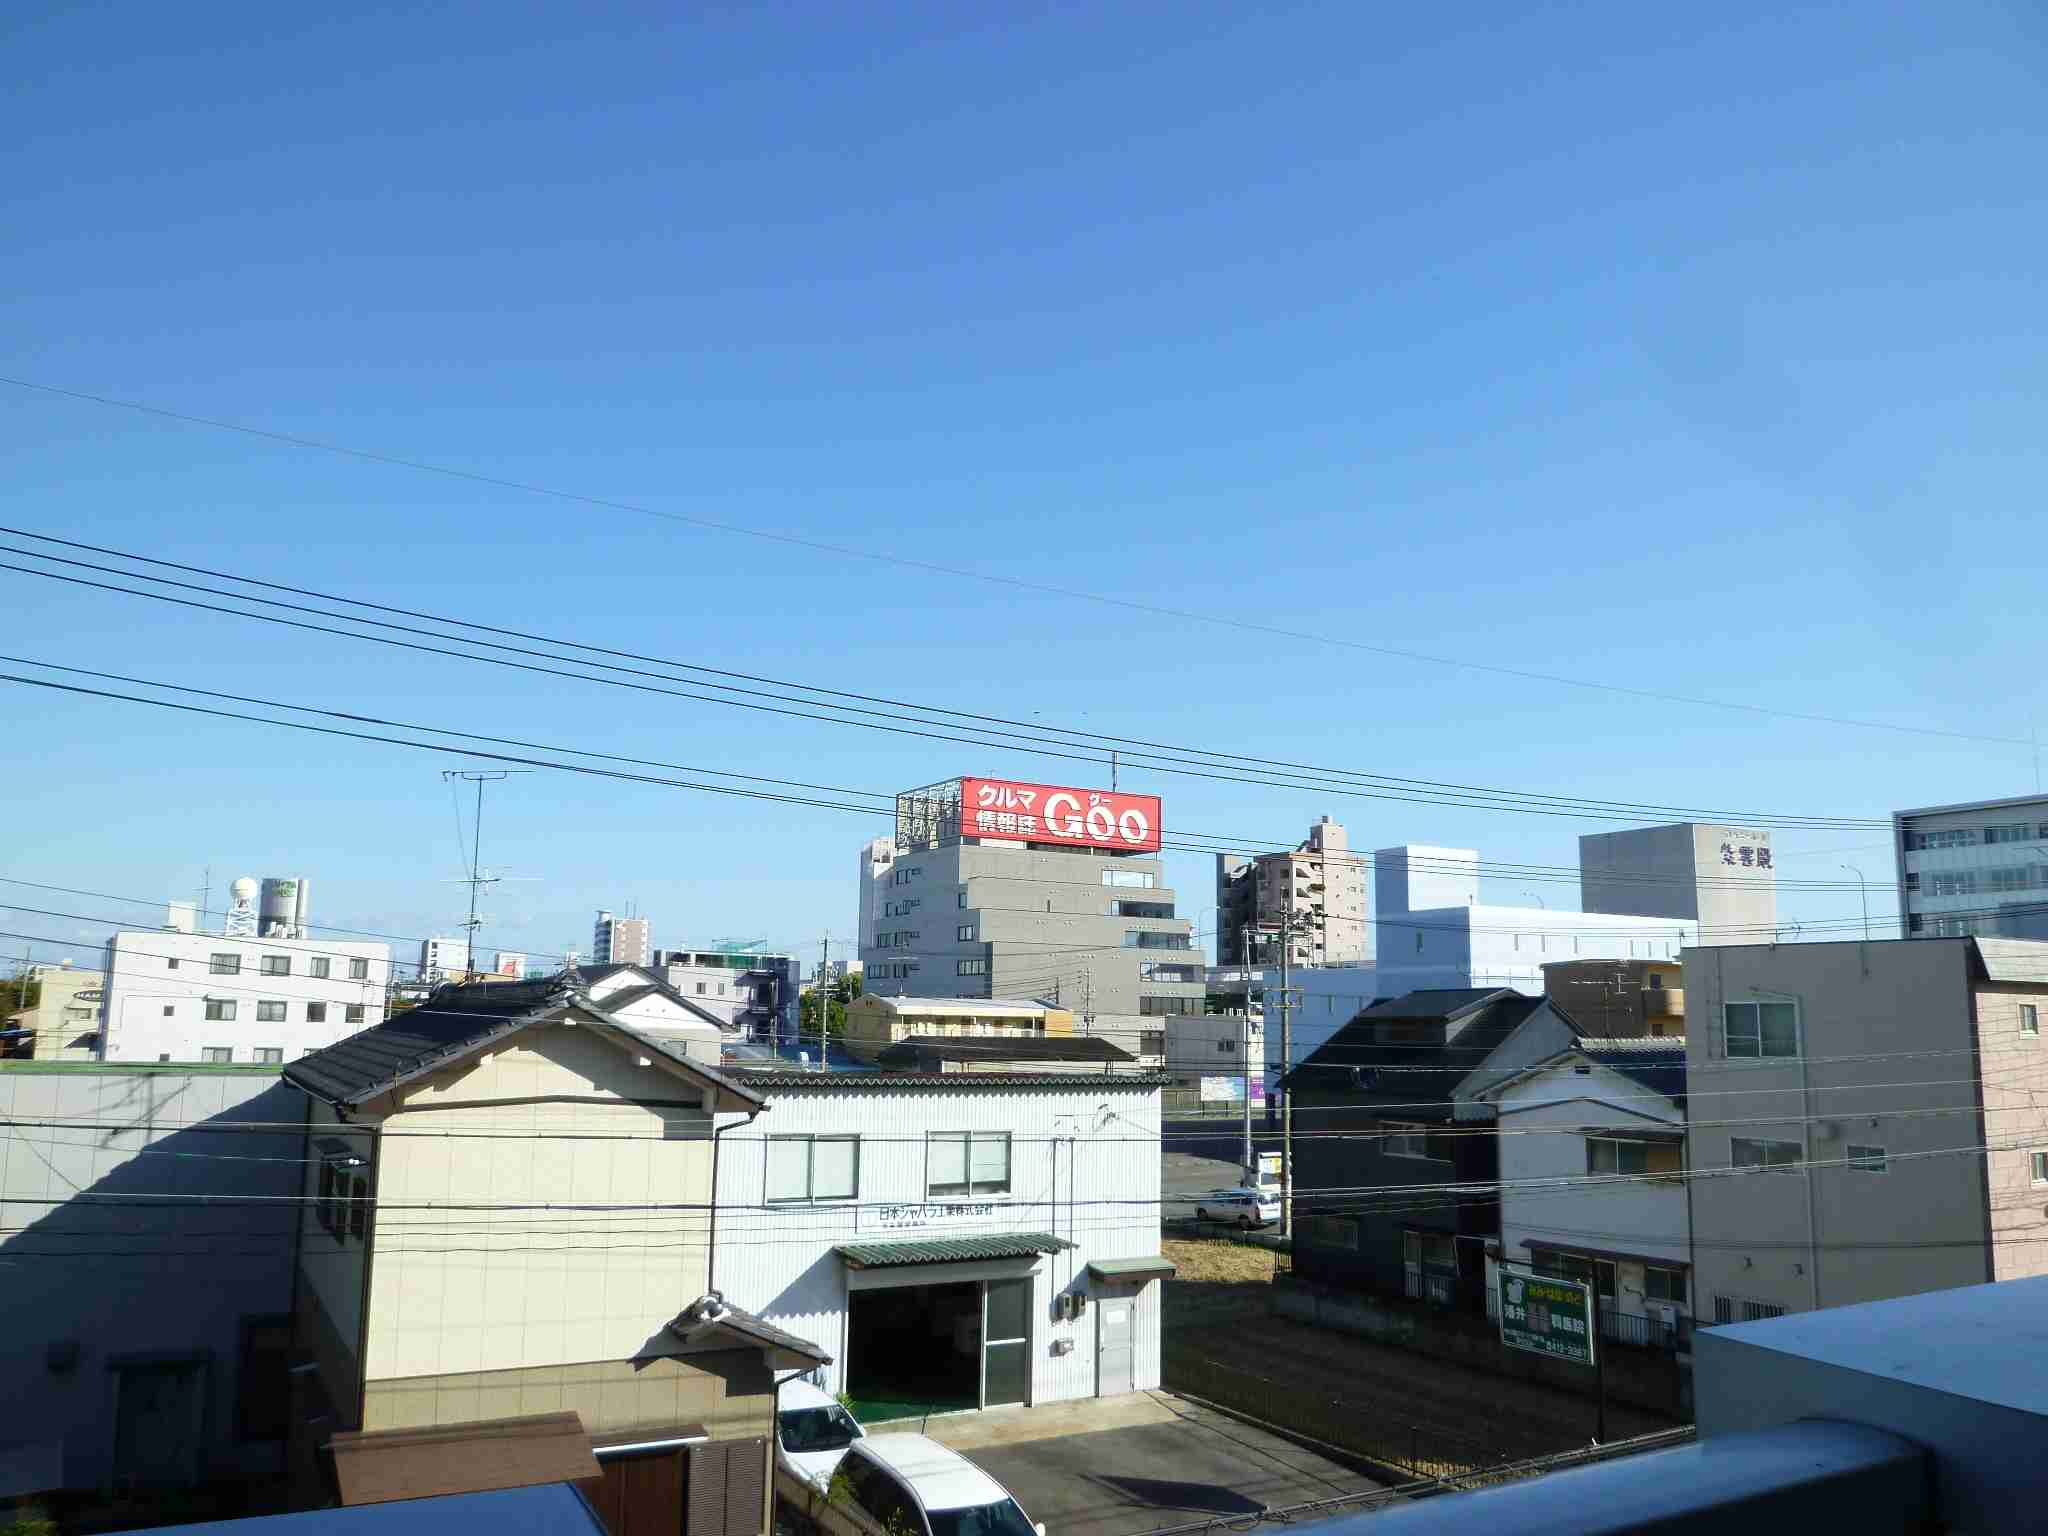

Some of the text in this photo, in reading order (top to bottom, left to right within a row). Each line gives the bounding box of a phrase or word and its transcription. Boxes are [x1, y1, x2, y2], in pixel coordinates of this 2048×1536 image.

[977, 784, 1037, 810] クルマ
[1043, 793, 1148, 844] Goo
